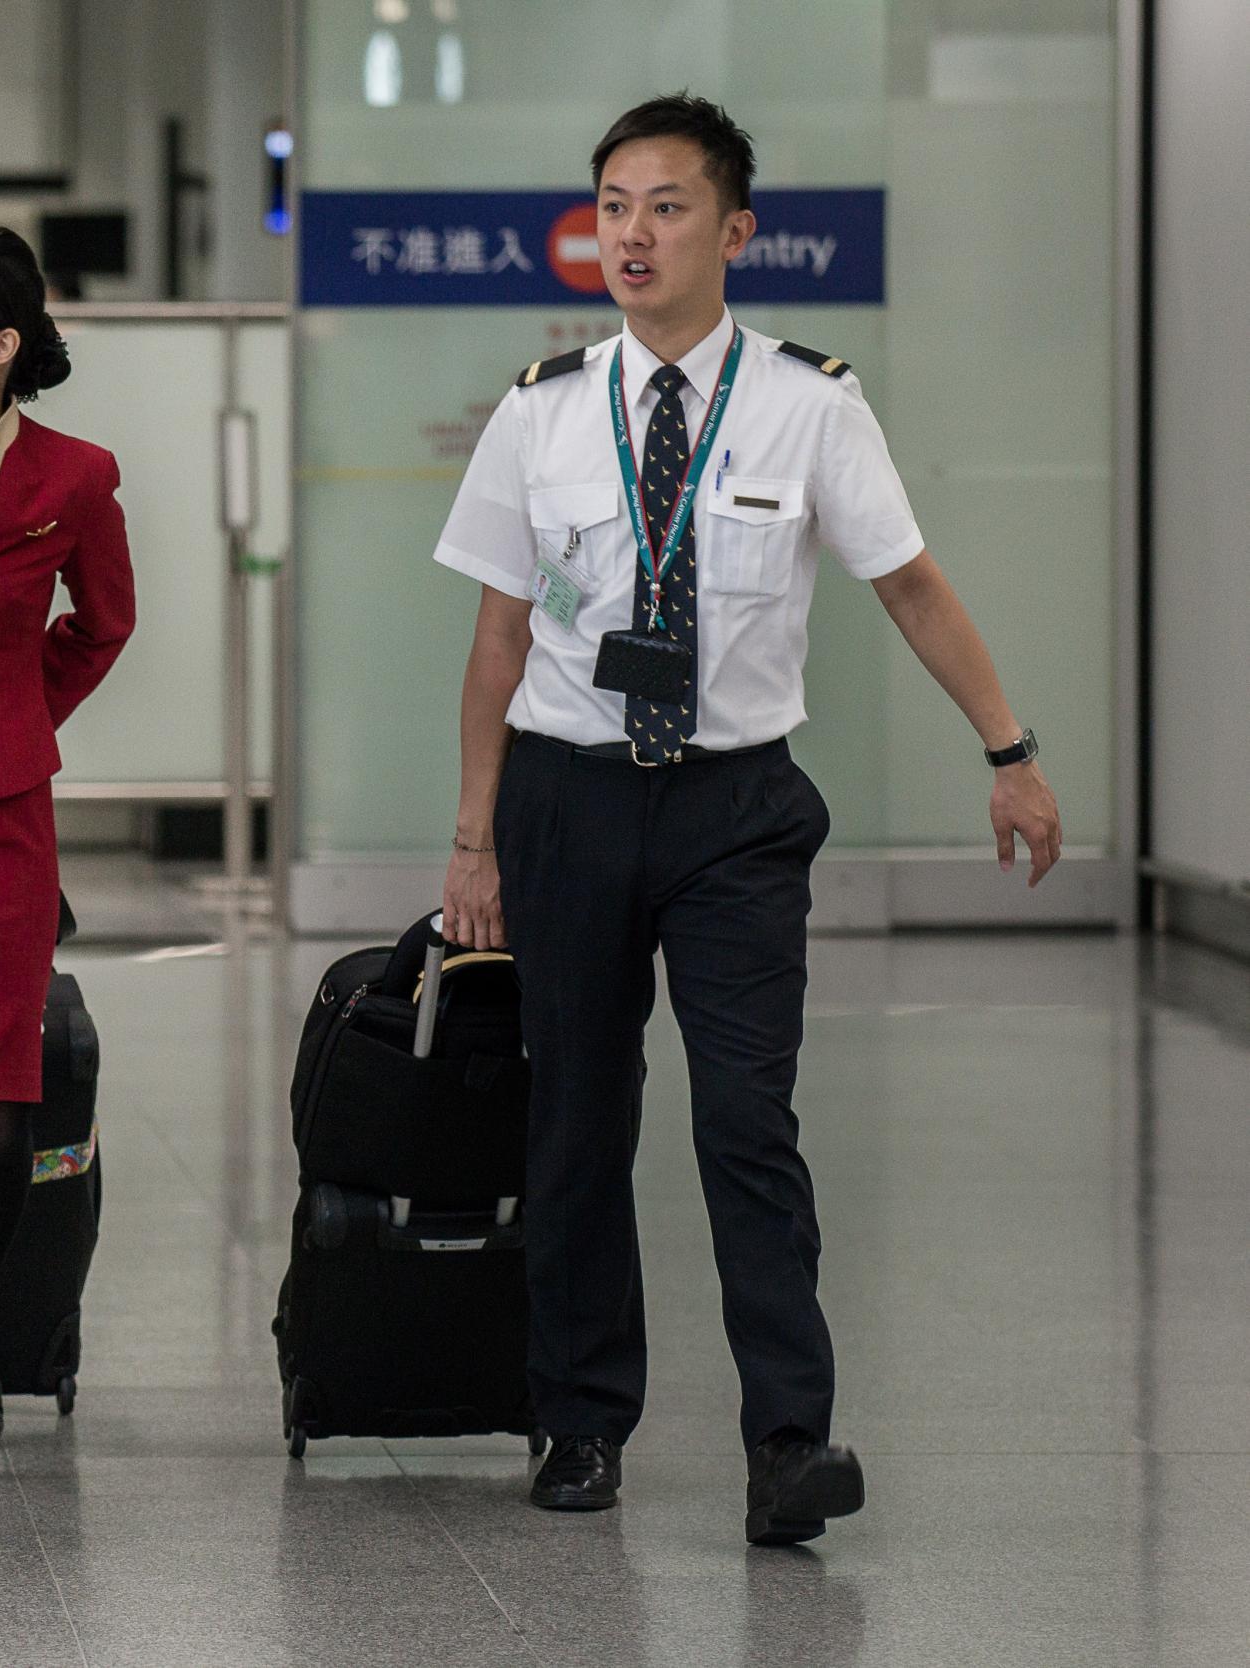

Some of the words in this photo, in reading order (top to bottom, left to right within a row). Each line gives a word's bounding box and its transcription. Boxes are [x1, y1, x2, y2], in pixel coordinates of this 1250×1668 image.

[351, 226, 534, 275] 不准進入
[709, 397, 723, 423] CATHAY
[701, 421, 715, 446] PACIFIC
[672, 497, 688, 524] CATHAY
[664, 522, 680, 547] PACIFIC
